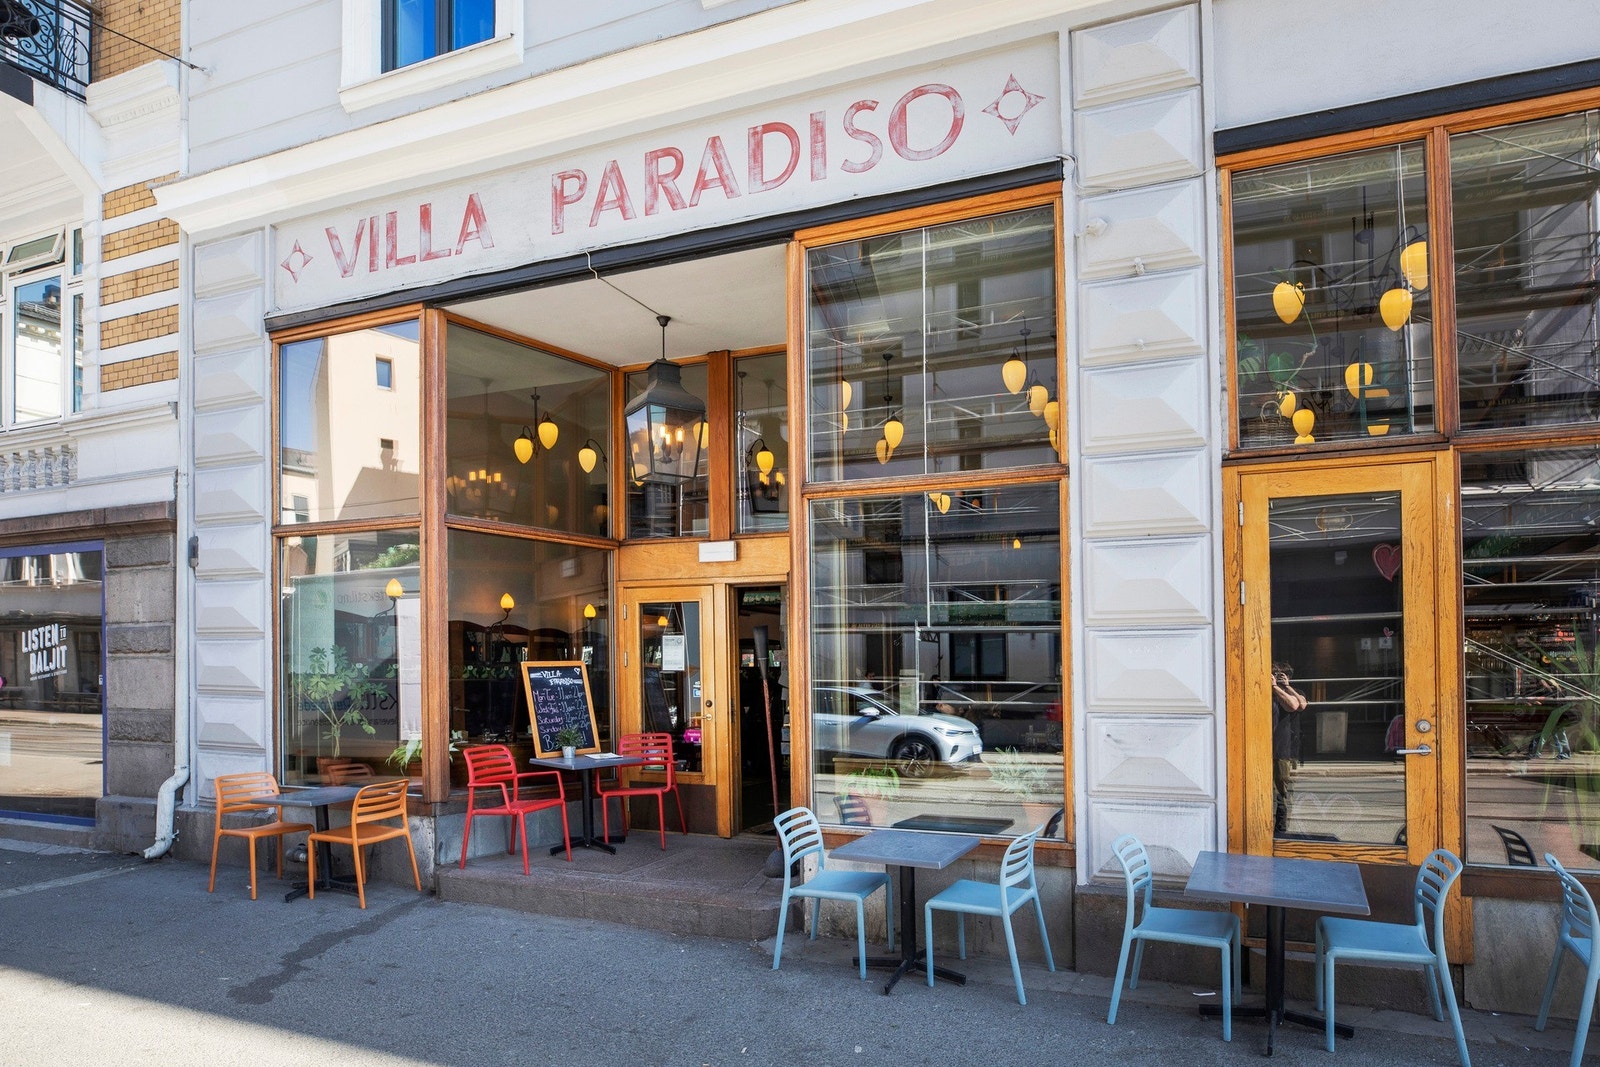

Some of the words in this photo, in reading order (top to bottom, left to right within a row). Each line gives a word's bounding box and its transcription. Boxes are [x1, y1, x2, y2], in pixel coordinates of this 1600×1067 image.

[325, 192, 495, 279] VILLA
[551, 83, 966, 236] PARADISO
[22, 623, 59, 653] LISTEN
[60, 628, 67, 638] TO
[30, 645, 68, 675] BALJIT
[540, 669, 562, 679] VILLA
